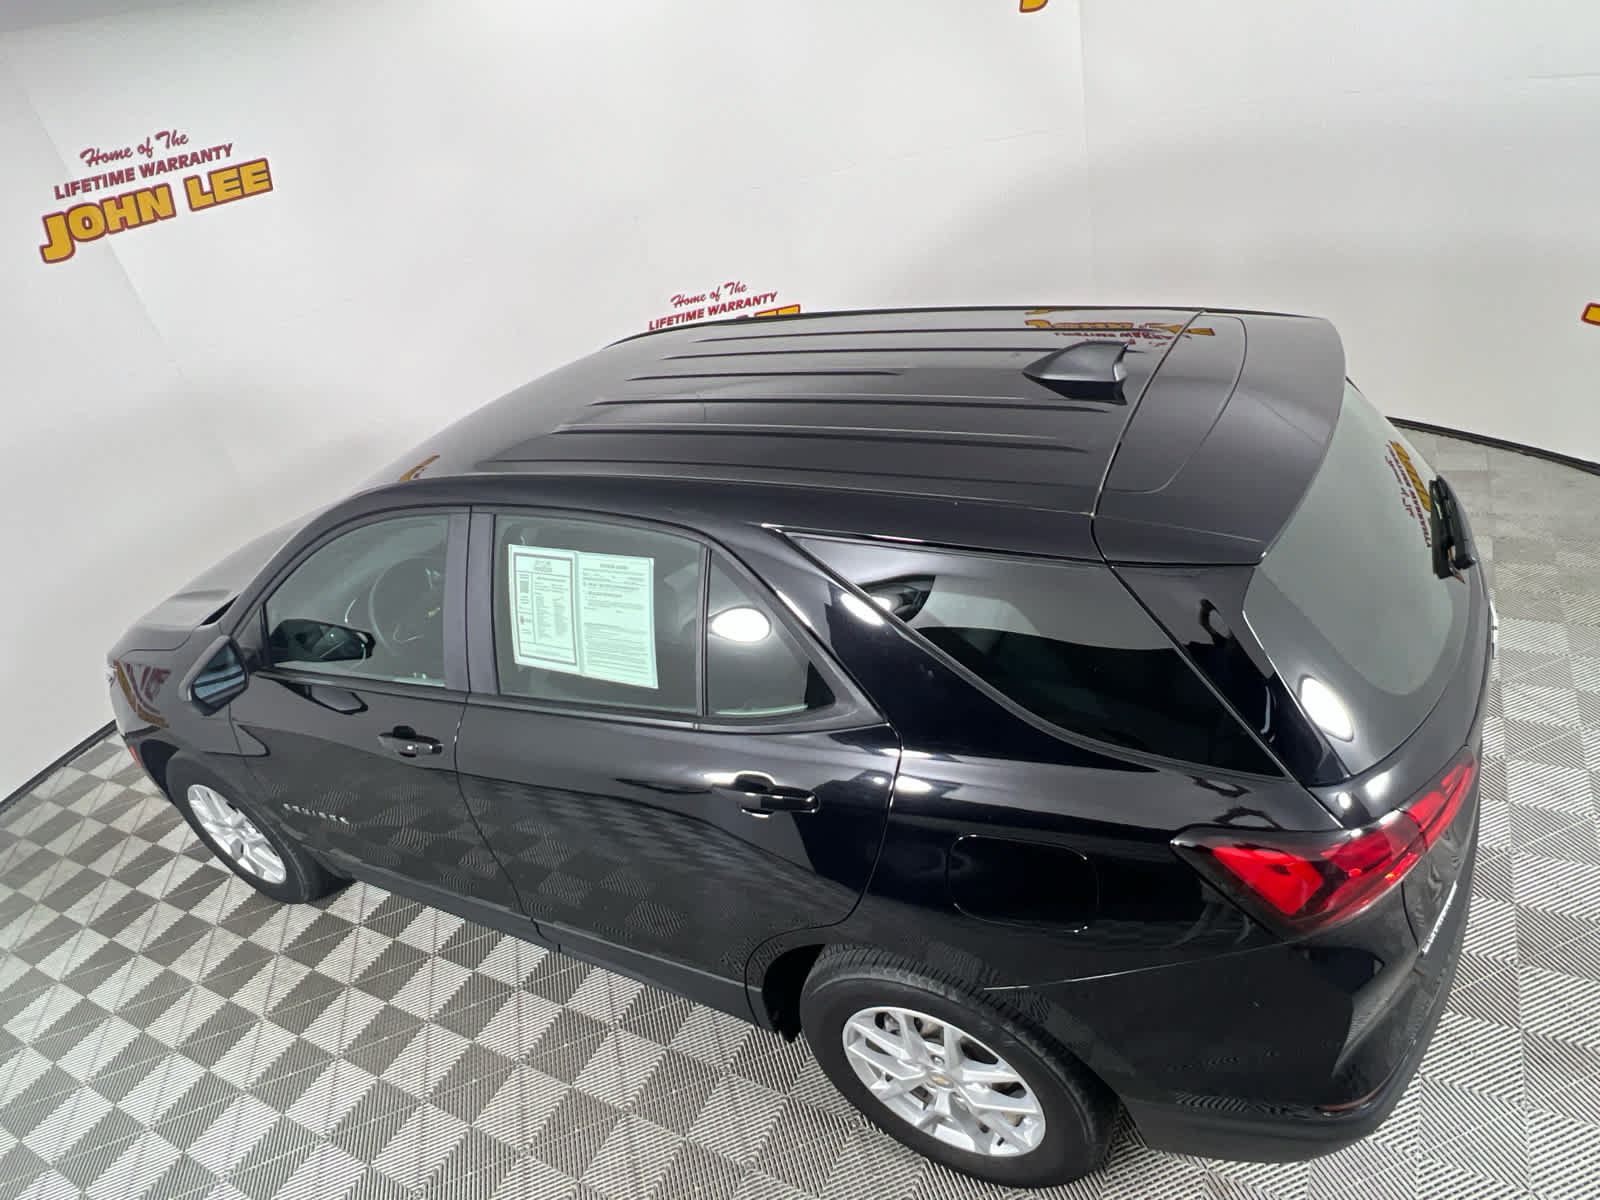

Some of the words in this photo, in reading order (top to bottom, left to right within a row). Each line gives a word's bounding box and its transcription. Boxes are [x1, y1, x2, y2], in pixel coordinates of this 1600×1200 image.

[79, 147, 134, 168] Home
[137, 136, 154, 159] of
[155, 129, 189, 150] The
[54, 167, 136, 200] LIFETIME
[138, 142, 233, 179] WARRANTY
[39, 183, 177, 264] JOHN
[183, 157, 274, 212] LEE
[648, 308, 705, 331] LIFETIME
[707, 291, 778, 316] WARRANTY
[670, 293, 707, 308] Home
[709, 285, 721, 302] of
[723, 281, 748, 296] The
